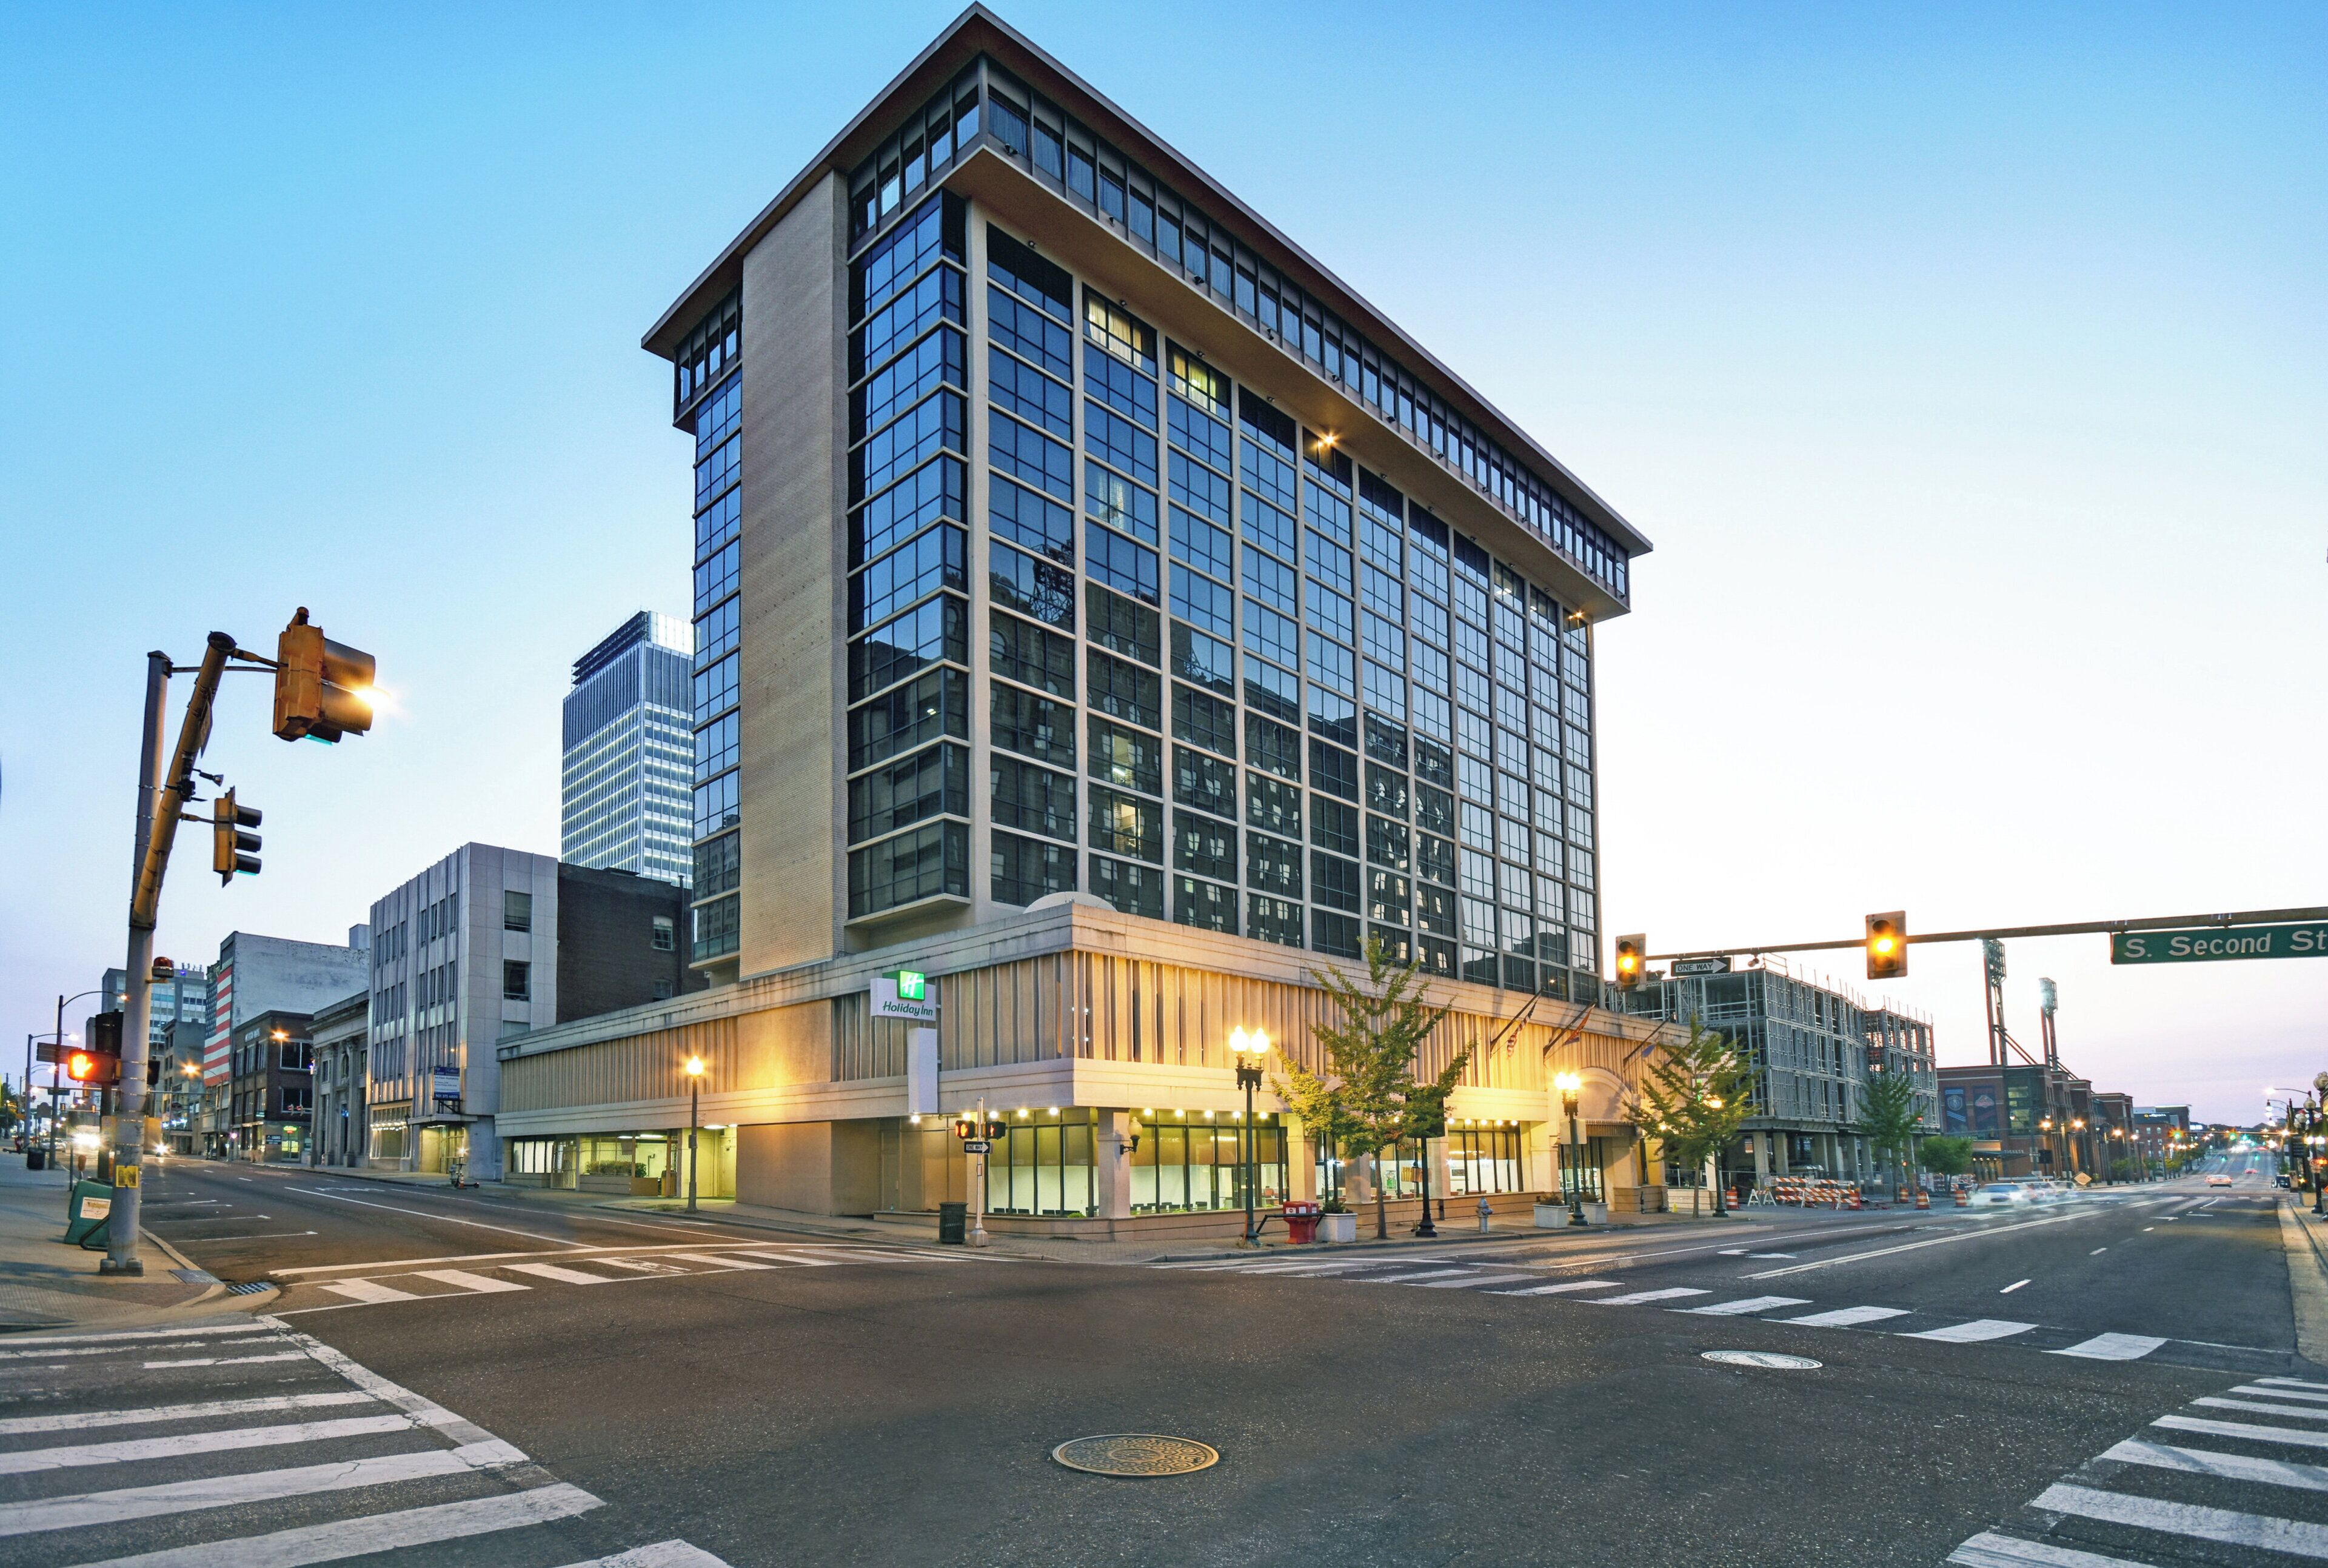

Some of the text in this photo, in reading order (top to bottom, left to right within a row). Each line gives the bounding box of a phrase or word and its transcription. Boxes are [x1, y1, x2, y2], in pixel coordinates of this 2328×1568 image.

[2124, 938, 2152, 958] S.
[2168, 932, 2271, 956] Second
[883, 1001, 933, 1016] Holiday Inn
